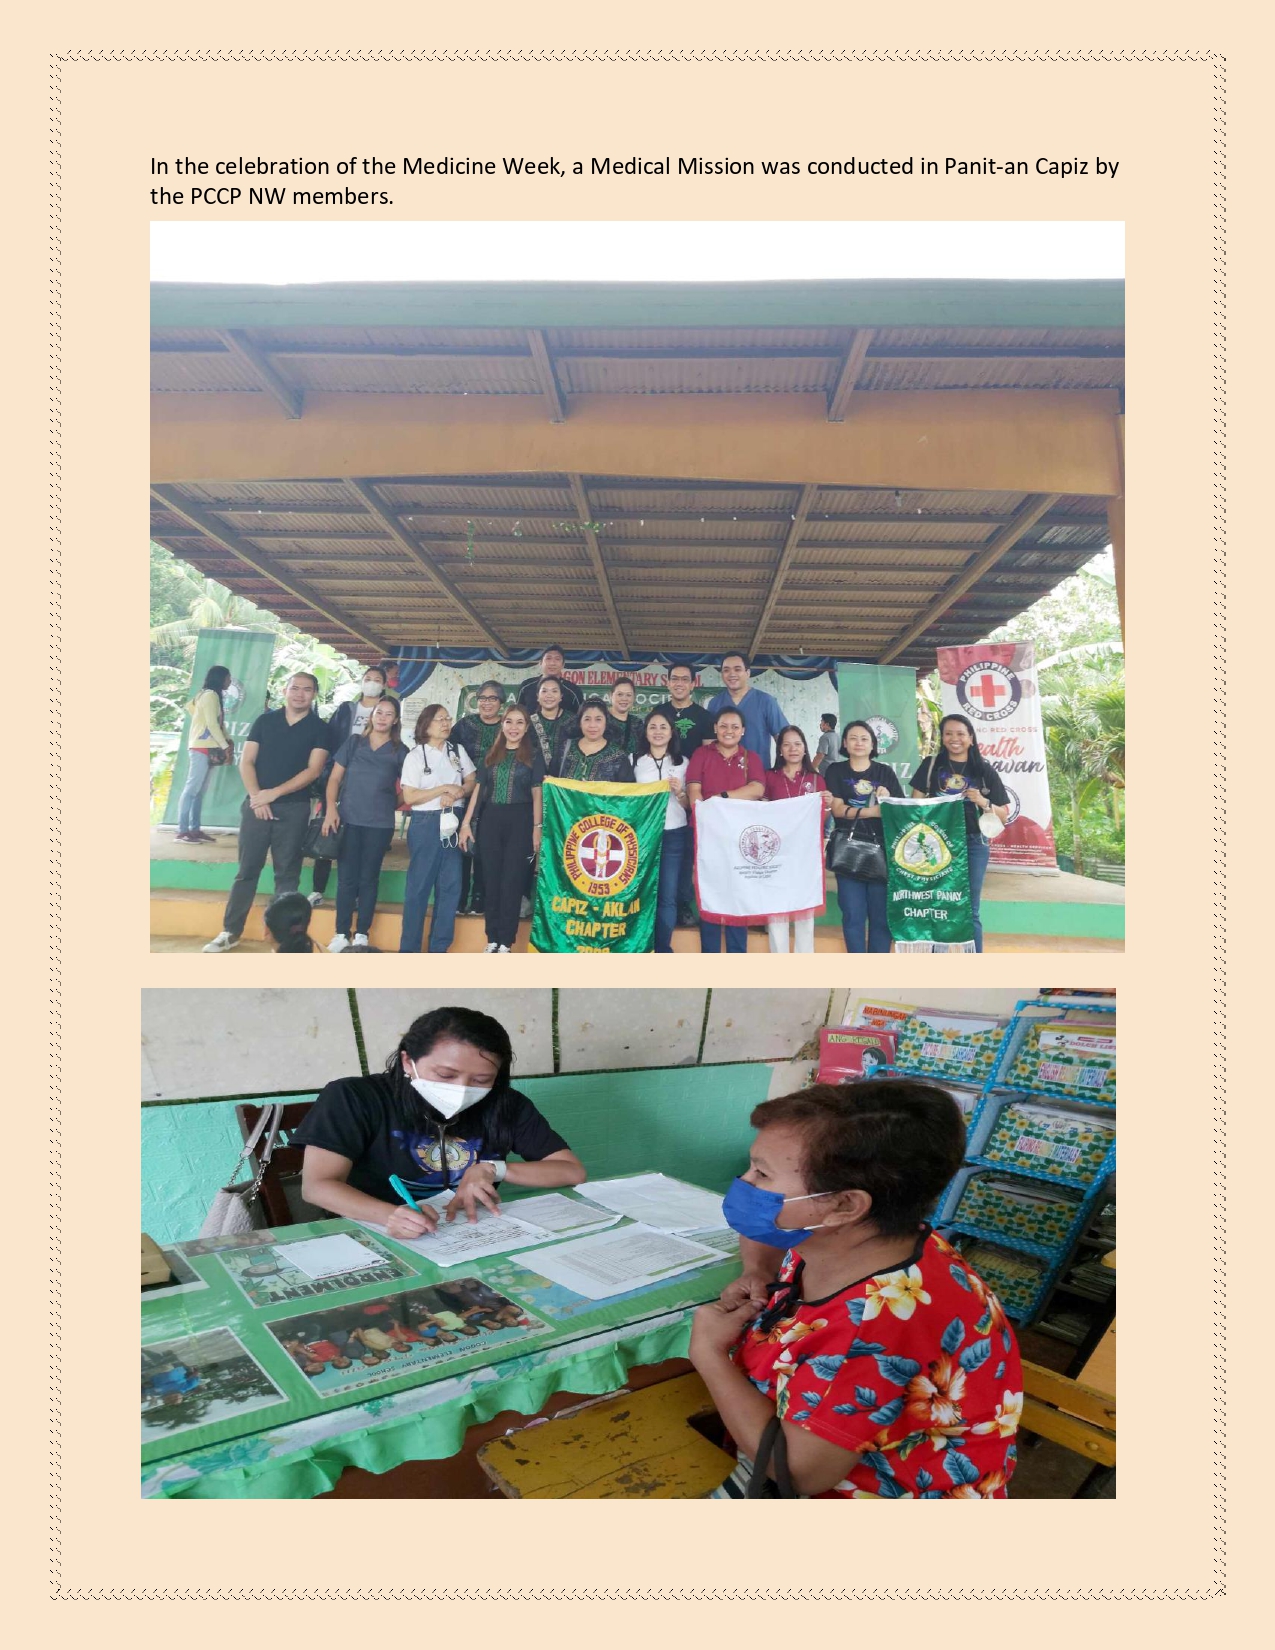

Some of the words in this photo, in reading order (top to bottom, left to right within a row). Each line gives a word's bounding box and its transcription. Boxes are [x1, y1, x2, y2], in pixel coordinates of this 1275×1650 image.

[960, 662, 1015, 682] PHILIPPINE
[963, 702, 982, 719] RED
[986, 700, 1018, 720] CROSS
[977, 736, 1025, 759] ealth
[578, 815, 617, 834] COLLEGE
[616, 822, 630, 835] OF
[565, 830, 583, 881] PHILIPPINE
[618, 832, 638, 885] PHYSICIANS
[588, 882, 611, 896] 1953
[893, 889, 934, 902] NORTHWEST
[936, 890, 963, 902] PANAY
[551, 896, 589, 916] CAPIZ
[602, 897, 641, 918] AKLAN
[903, 907, 948, 920] CHAPTER
[565, 918, 627, 939] CHAPTER
[268, 1267, 404, 1303] ENROLMENT
[367, 1365, 396, 1377] SCHOOL
